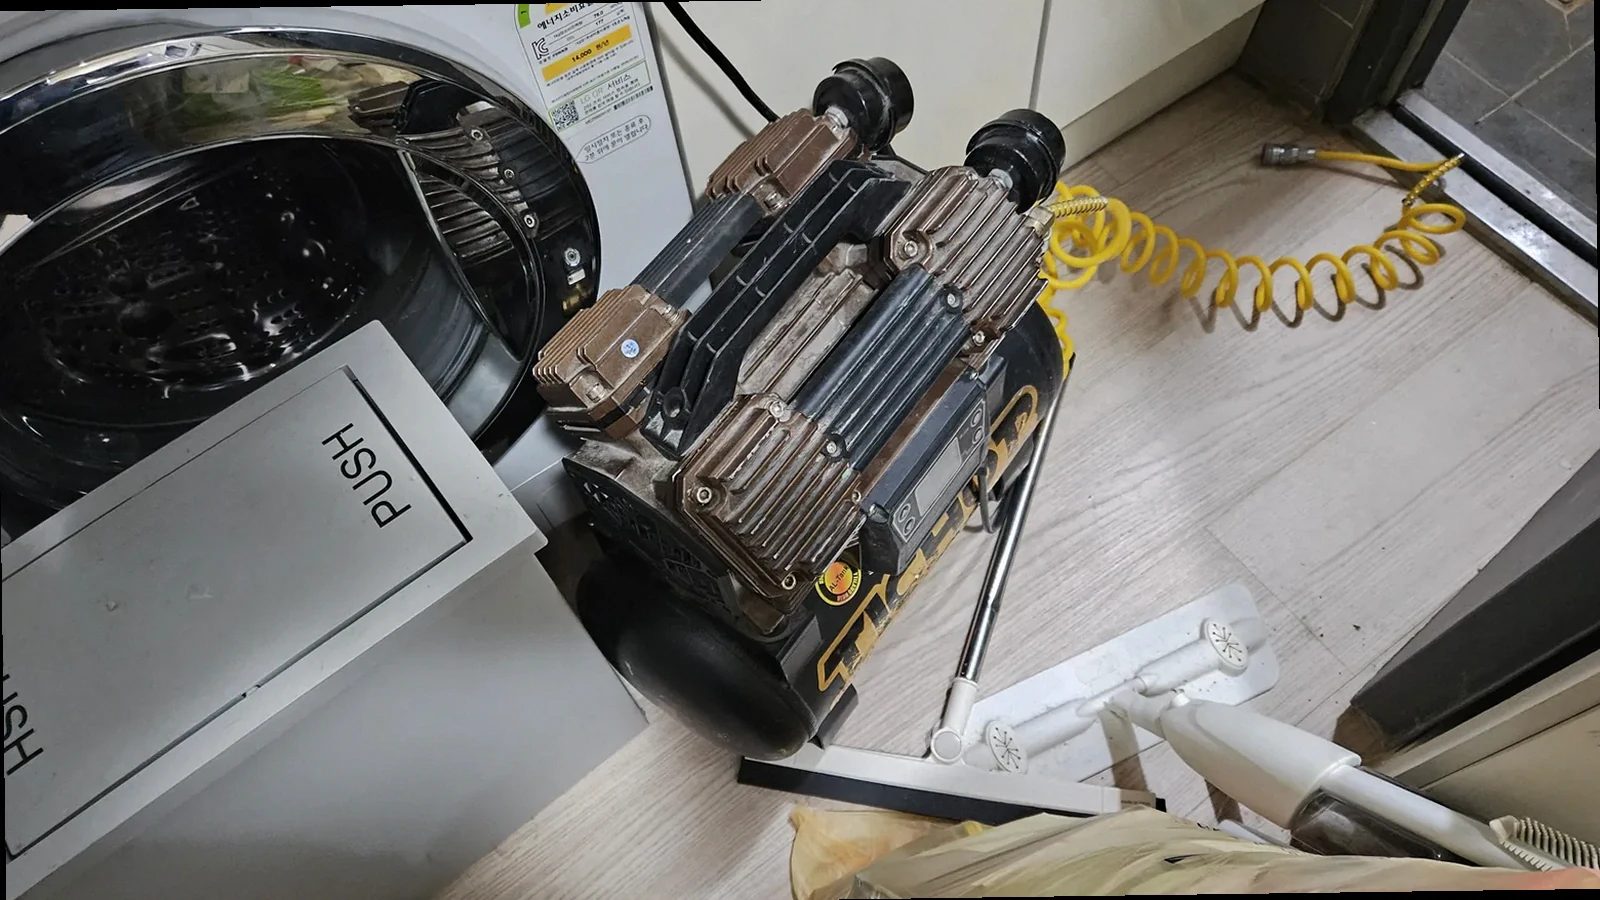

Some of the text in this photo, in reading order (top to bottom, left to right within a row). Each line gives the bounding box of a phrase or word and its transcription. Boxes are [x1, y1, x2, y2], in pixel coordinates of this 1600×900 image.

[571, 48, 592, 63] 14,000
[607, 73, 631, 90] 서비스
[624, 124, 648, 141] 열립니다
[321, 422, 412, 528] PUSH
[829, 565, 849, 591] AL-Tank
